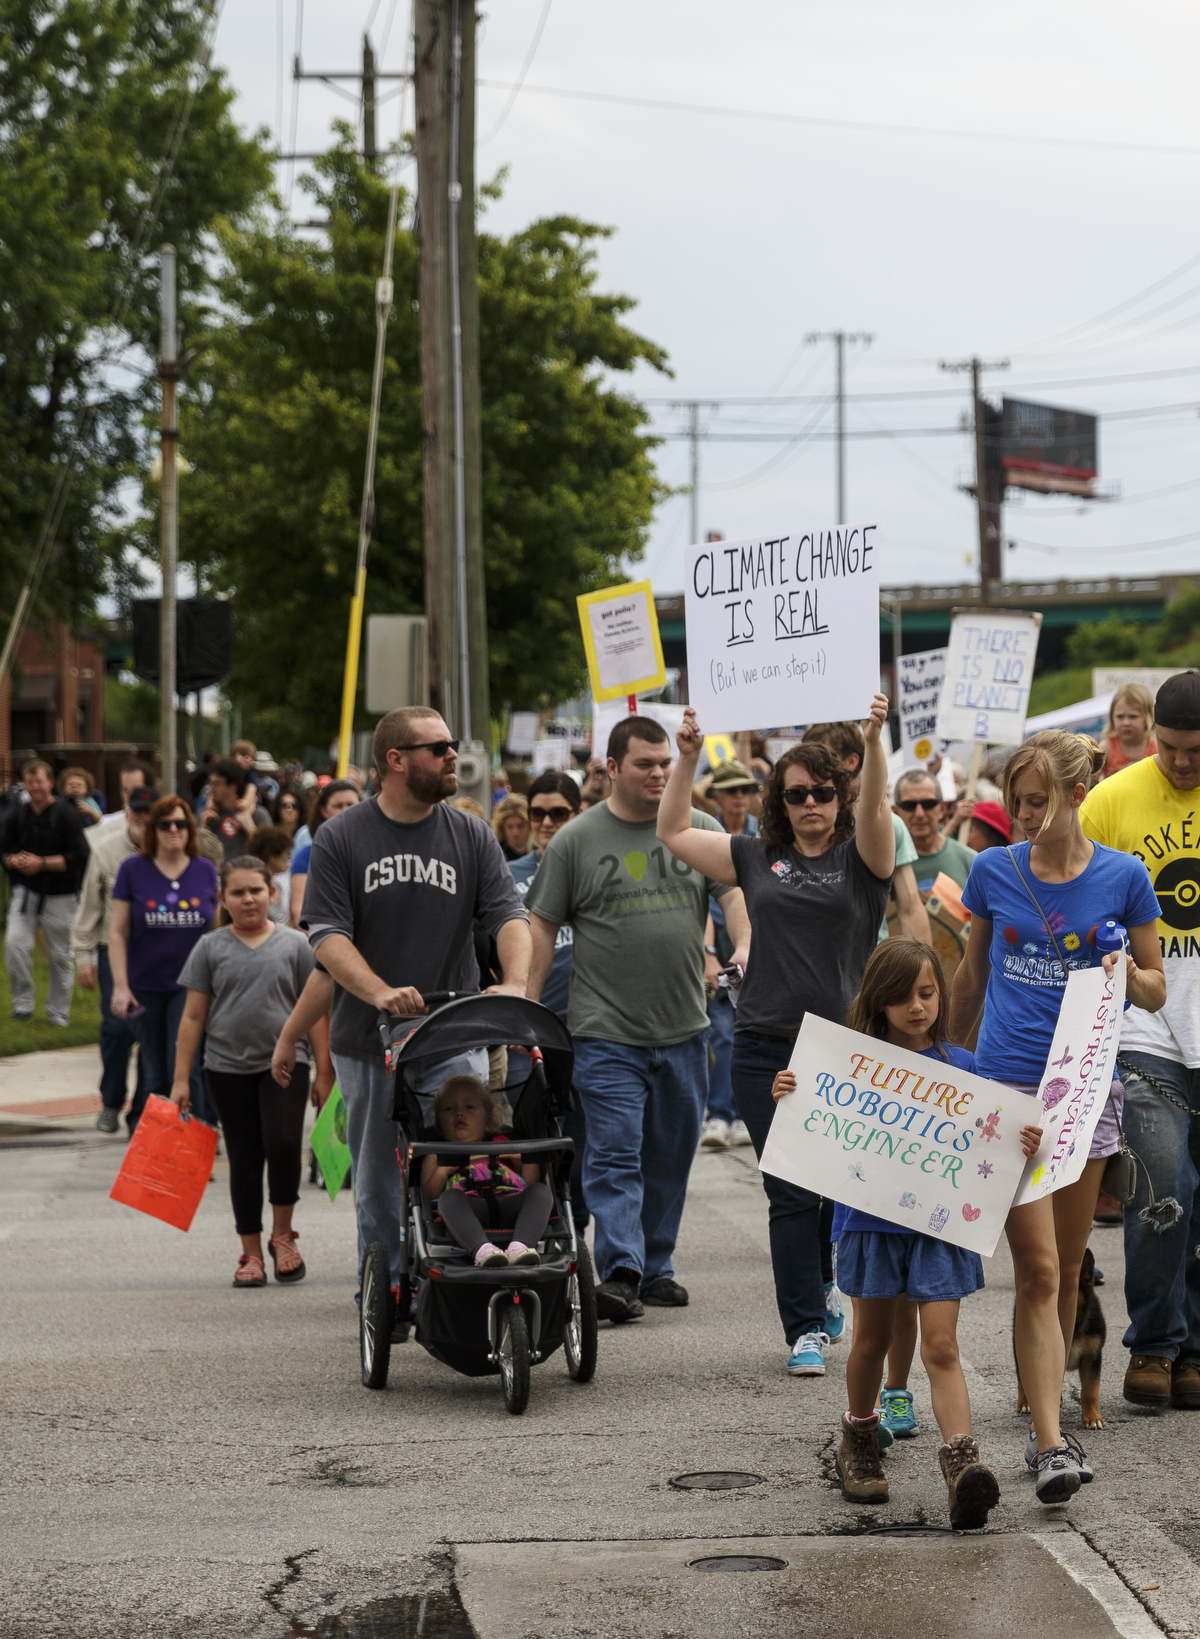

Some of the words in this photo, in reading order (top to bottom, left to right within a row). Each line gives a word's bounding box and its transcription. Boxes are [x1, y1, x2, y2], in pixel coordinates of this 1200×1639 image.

[694, 536, 790, 599] CLIMATE
[796, 525, 877, 582] CHANGE
[724, 599, 755, 643] IS
[774, 588, 829, 637] REAL
[963, 627, 1029, 656] THERE
[710, 657, 738, 695] (But
[742, 666, 758, 684] we
[761, 664, 781, 680] can
[961, 654, 983, 680] IS
[992, 657, 1025, 682] NO
[953, 682, 1028, 711] PLANET
[974, 712, 990, 735] B
[364, 853, 456, 895] CSUMB
[1003, 972, 1021, 983] MARCH
[1019, 976, 1031, 985] FOR
[1030, 979, 1054, 987] SCIENCE
[849, 1053, 975, 1118] FUTURE
[1050, 980, 1115, 1166] ASTRONAUT
[1076, 1008, 1118, 1132] FUTURE
[814, 1072, 975, 1152] ROBOTICS
[803, 1109, 964, 1190] ENGINEER
